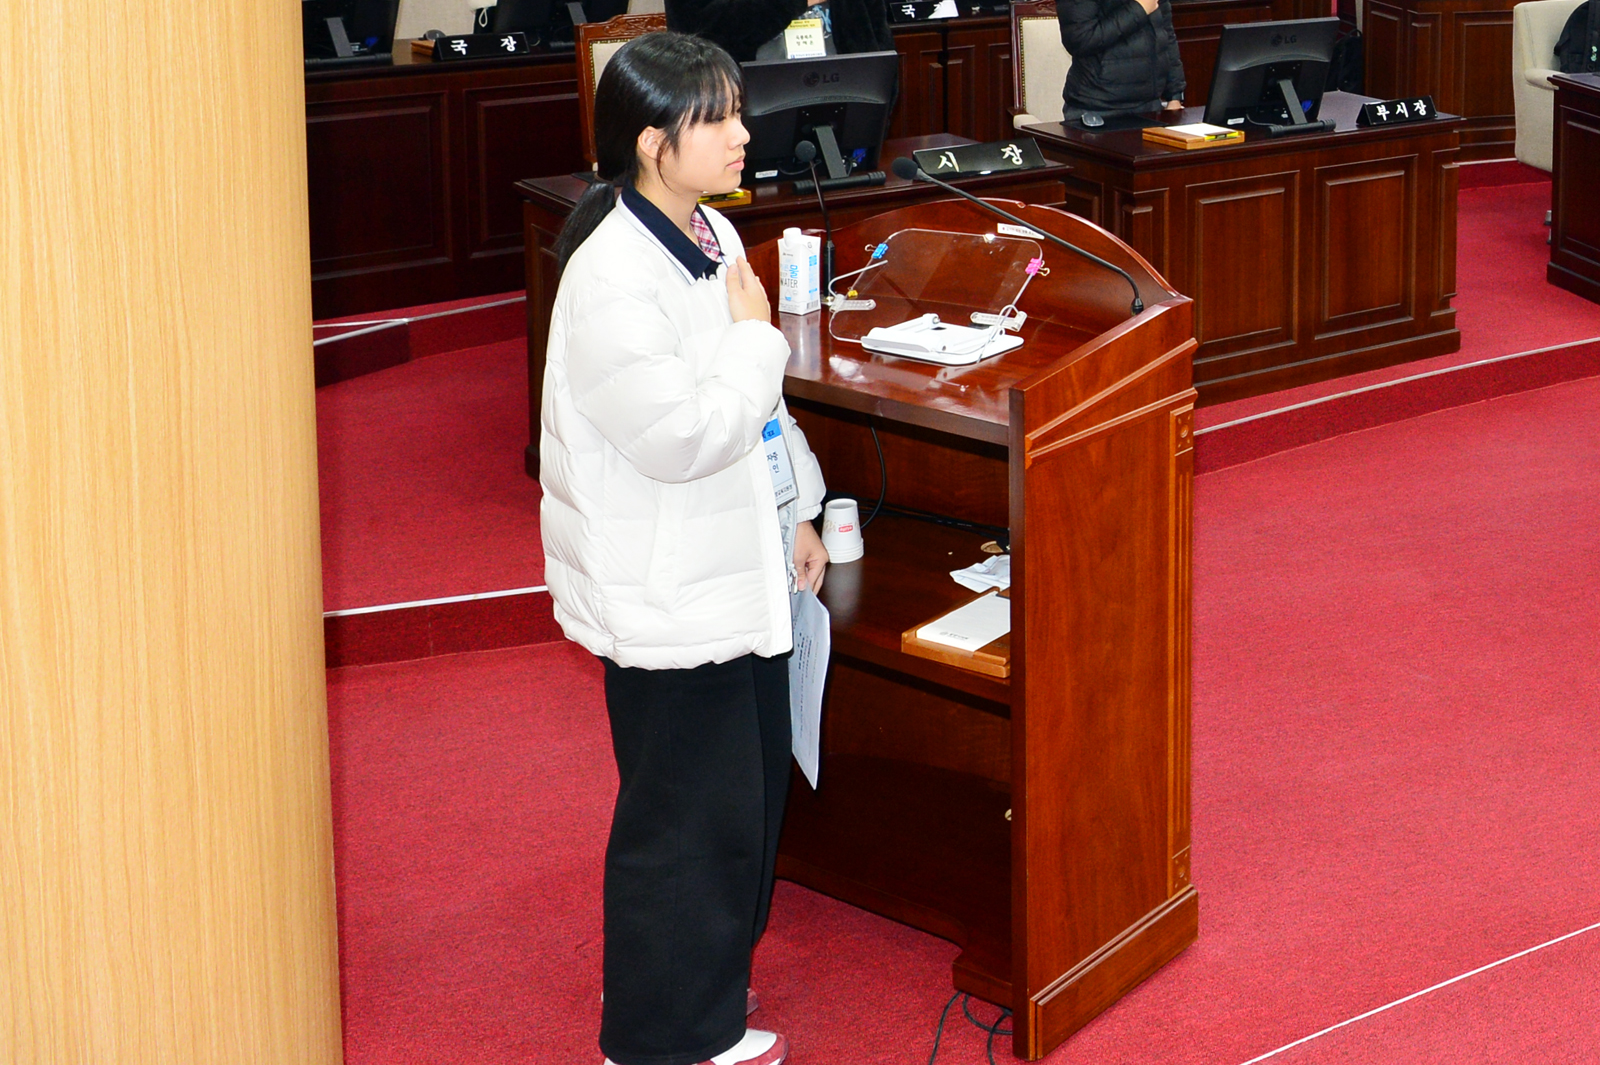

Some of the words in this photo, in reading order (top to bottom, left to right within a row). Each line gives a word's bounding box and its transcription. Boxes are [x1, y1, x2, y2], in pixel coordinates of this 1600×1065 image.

[1284, 35, 1297, 44] LG
[822, 73, 840, 84] LG
[1376, 99, 1427, 122] 부시장
